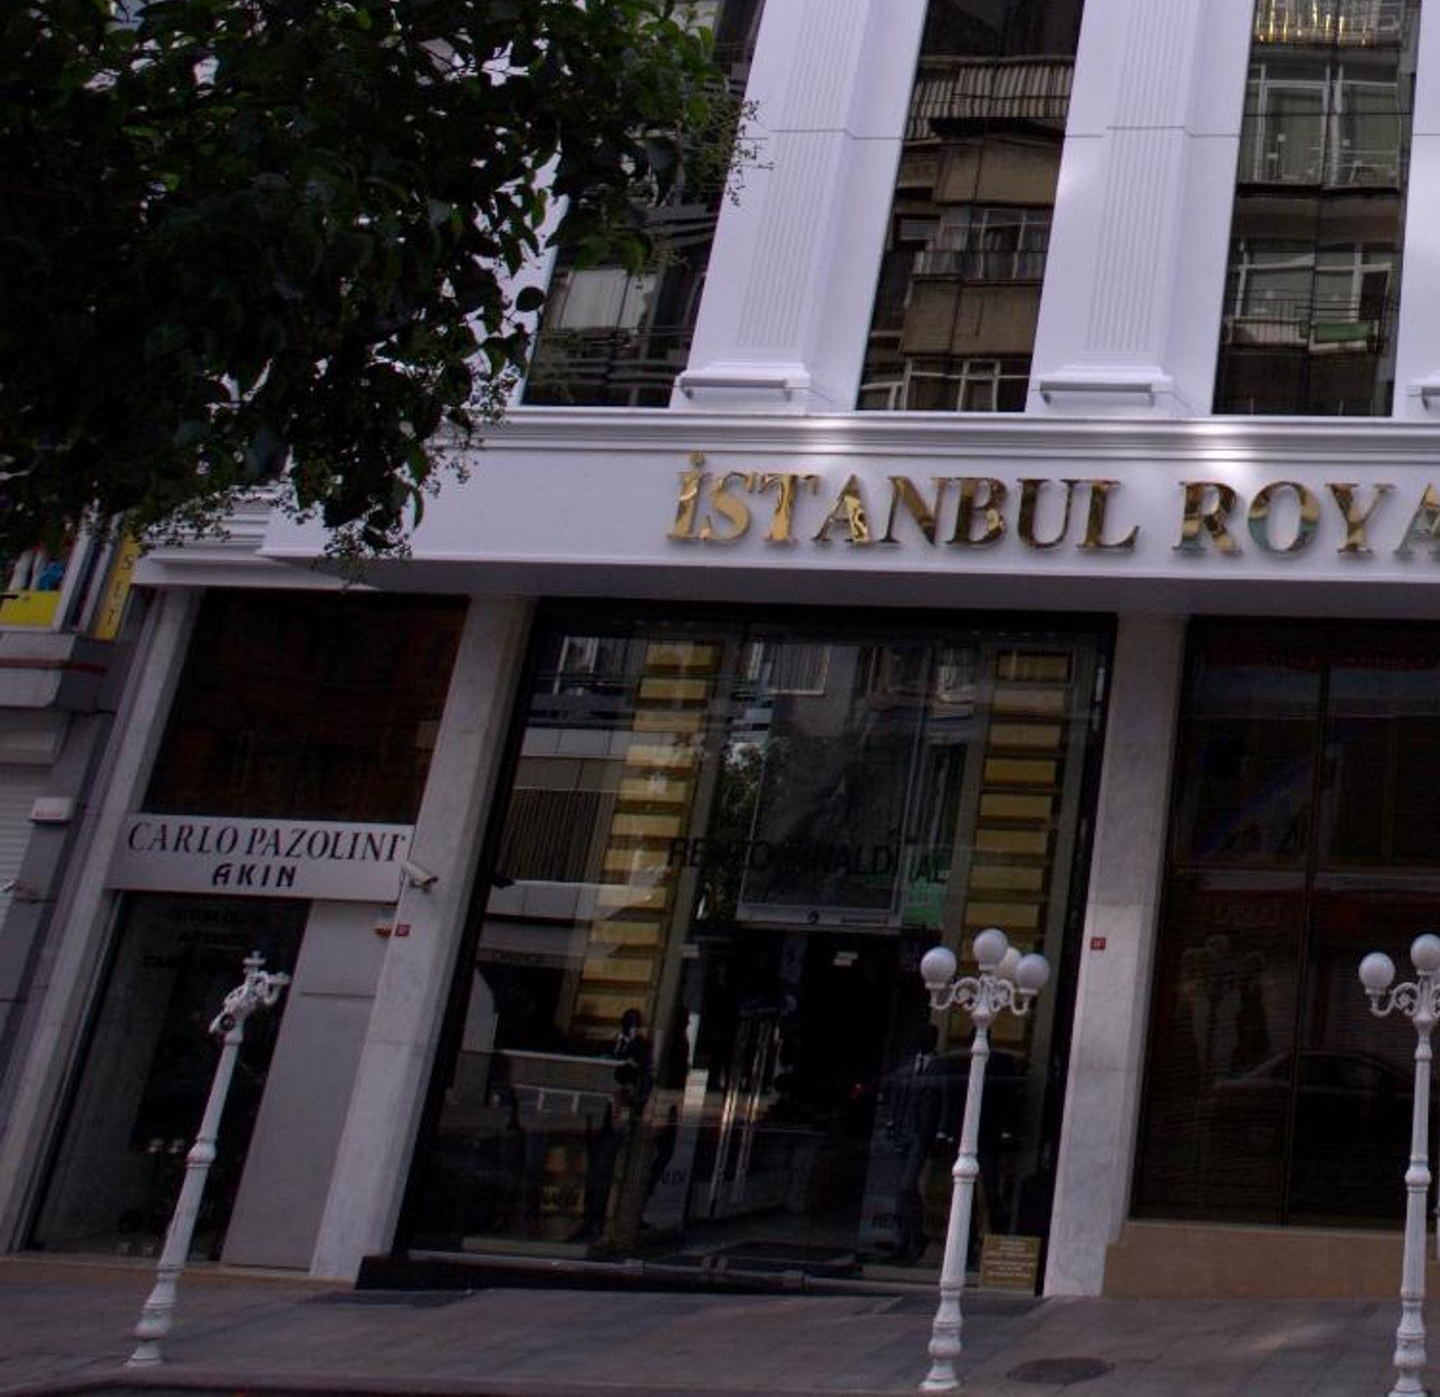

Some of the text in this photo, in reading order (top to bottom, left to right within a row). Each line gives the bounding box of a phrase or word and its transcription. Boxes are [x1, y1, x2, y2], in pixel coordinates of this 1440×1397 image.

[667, 451, 1140, 551] İSTANBUL
[128, 822, 404, 862] CARLO PAZOLINI
[211, 862, 297, 888] AKIN
